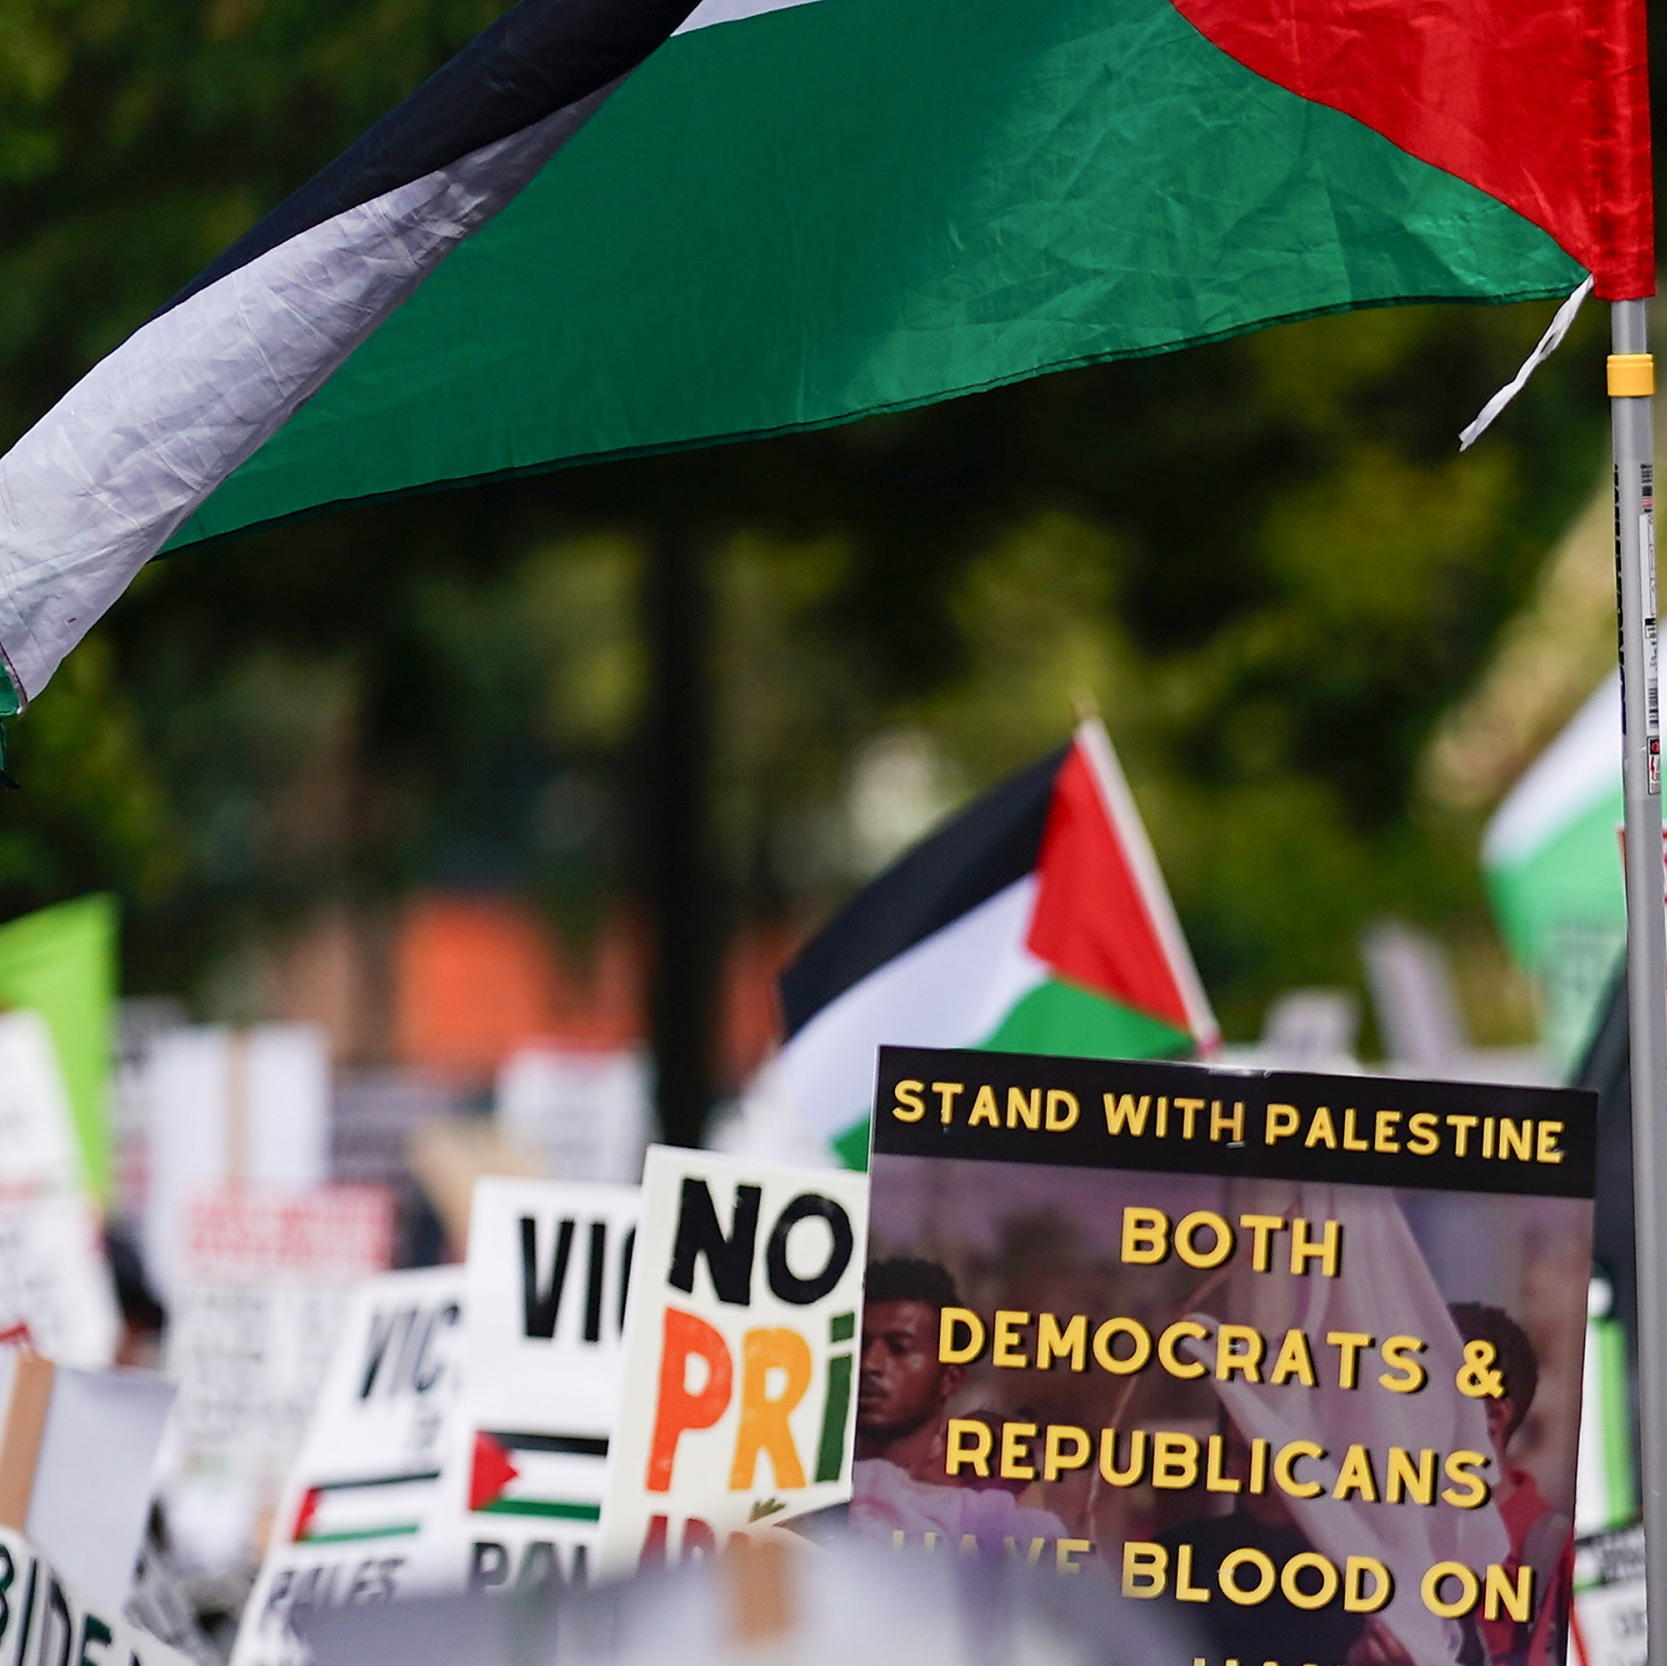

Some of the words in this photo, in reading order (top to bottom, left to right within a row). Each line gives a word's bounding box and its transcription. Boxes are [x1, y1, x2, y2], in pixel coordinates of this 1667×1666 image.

[892, 1080, 1079, 1133] STAND
[1104, 1094, 1246, 1145] WITH
[1265, 1103, 1564, 1164] PALESTINE
[520, 1216, 635, 1344] VI
[668, 1179, 853, 1307] NO
[1121, 1207, 1341, 1277] BOTH
[938, 1306, 1427, 1394] DEMOCRATS
[1456, 1339, 1507, 1399] &
[945, 1418, 1492, 1510] REPUBLICANS
[1121, 1542, 1395, 1613] BLOOD
[1420, 1559, 1533, 1623] ON
